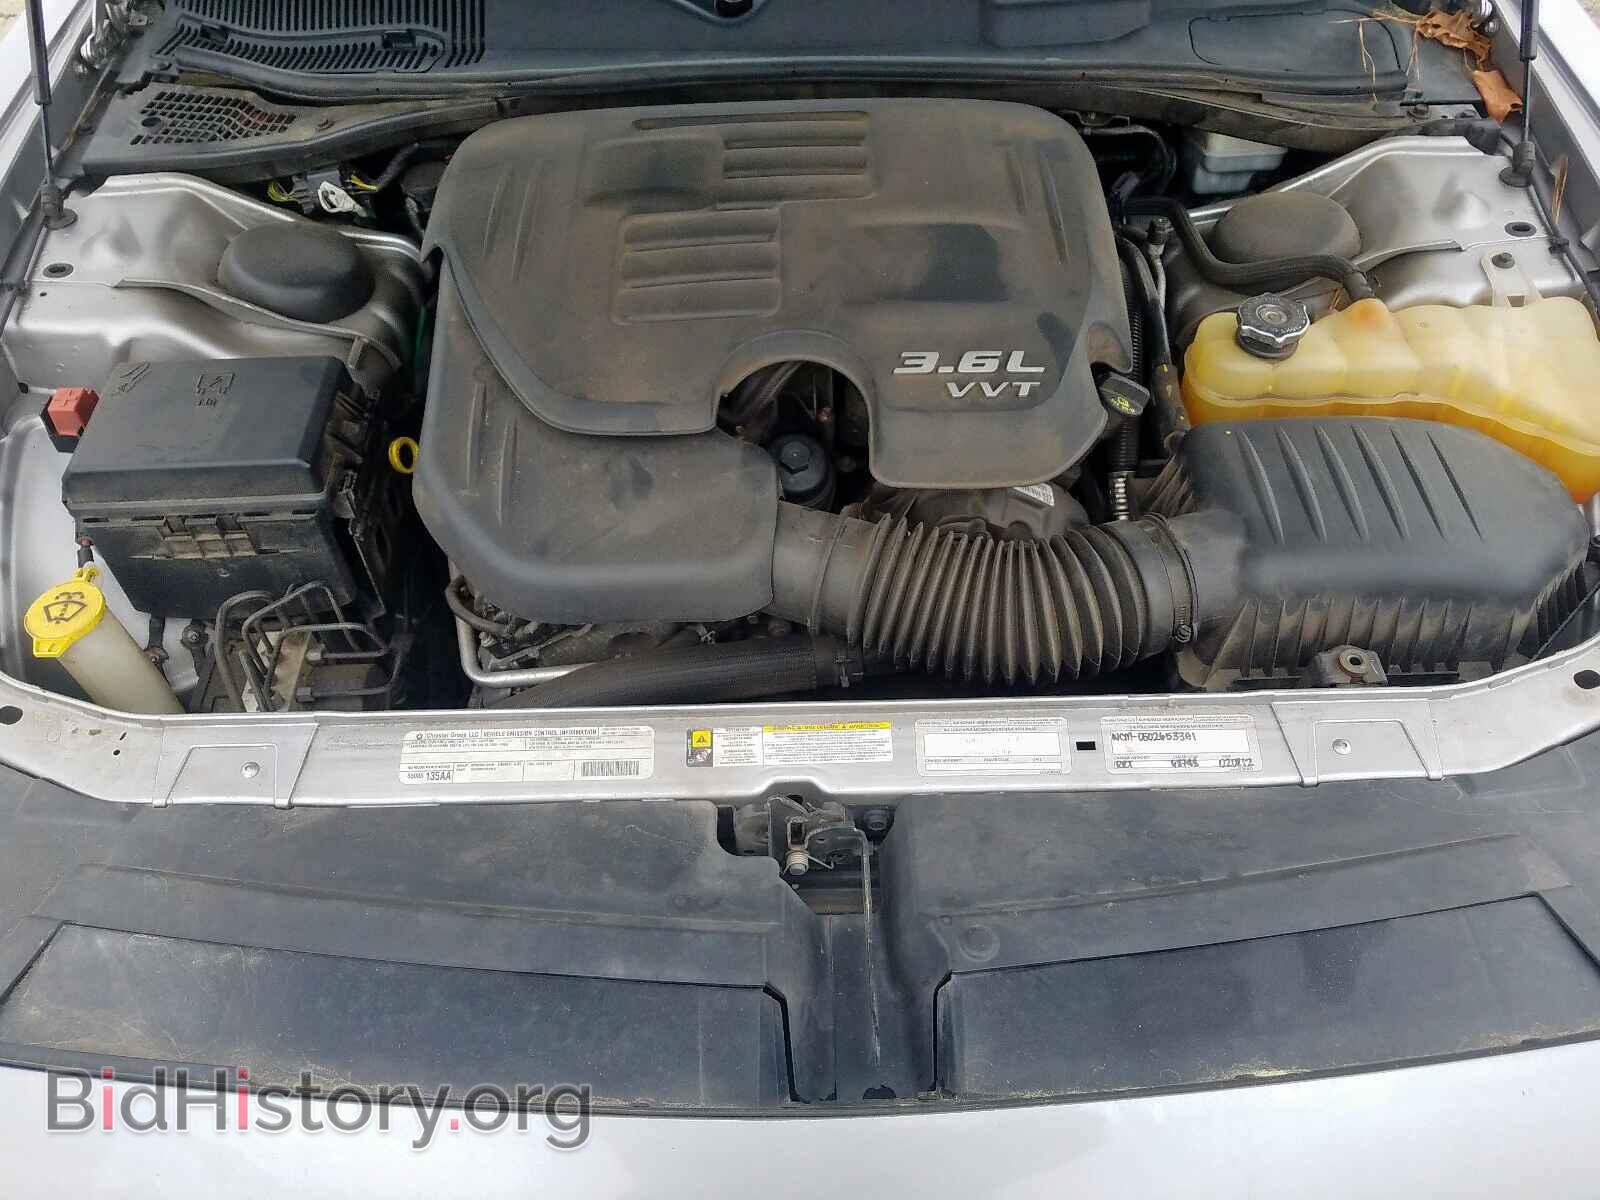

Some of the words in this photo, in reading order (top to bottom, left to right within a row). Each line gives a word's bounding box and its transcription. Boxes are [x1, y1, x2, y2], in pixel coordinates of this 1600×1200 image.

[893, 350, 1046, 375] 3.6L
[945, 381, 1041, 398] VVT
[468, 730, 479, 738] LLC
